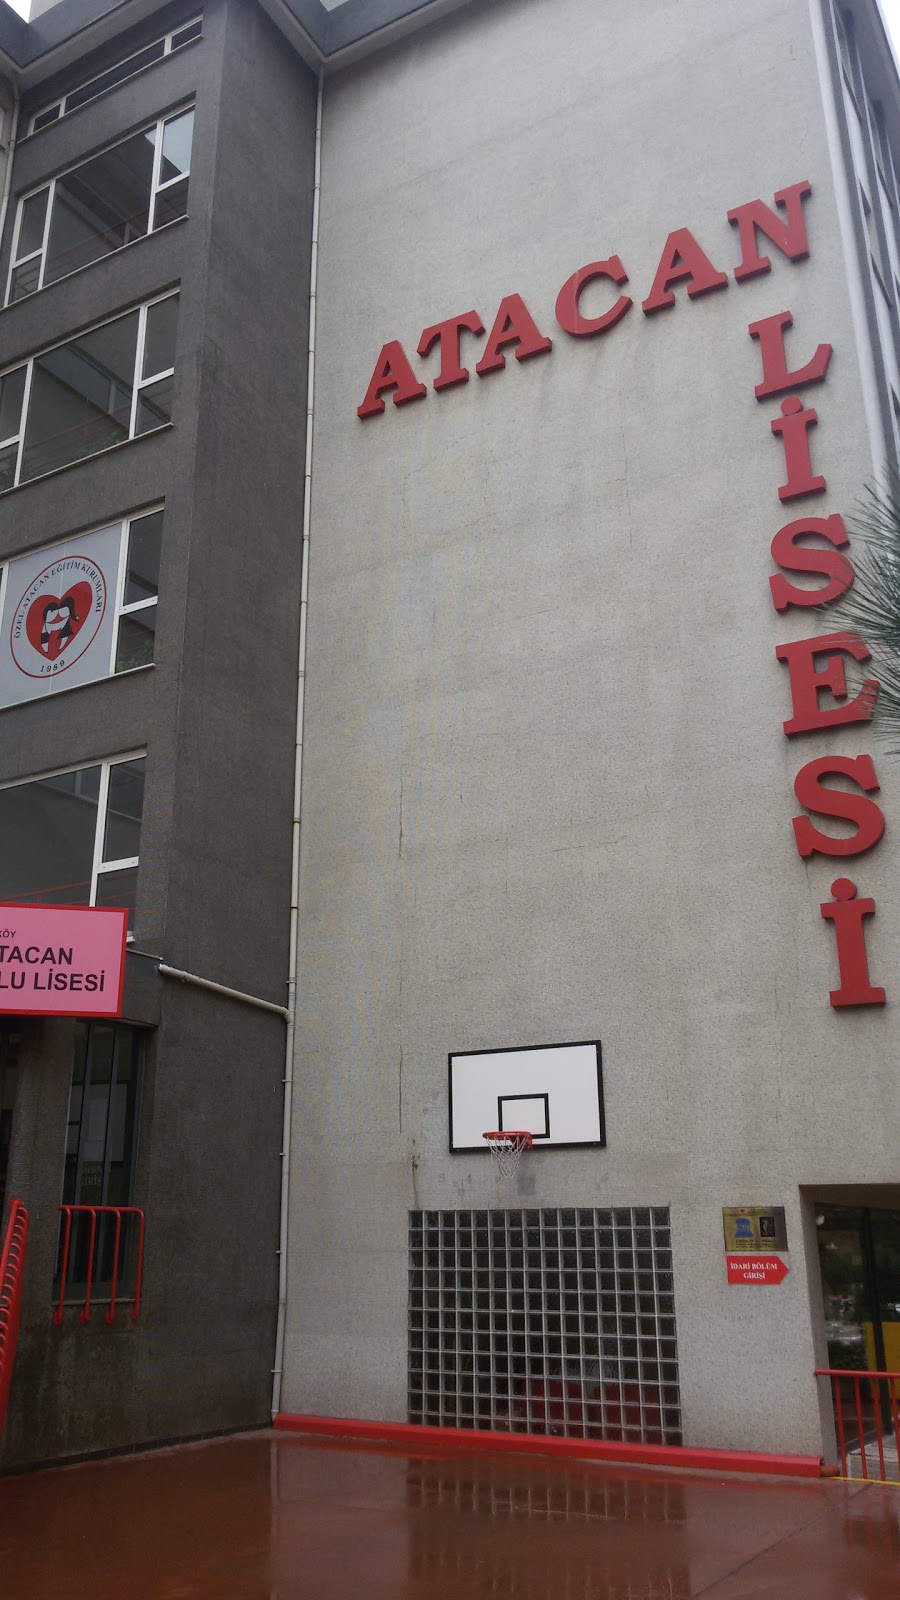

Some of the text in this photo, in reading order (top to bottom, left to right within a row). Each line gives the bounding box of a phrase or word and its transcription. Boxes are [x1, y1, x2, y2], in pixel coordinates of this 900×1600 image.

[357, 180, 813, 420] ATACAN
[14, 611, 25, 639] ÖZEL
[23, 574, 50, 610] ATACAN
[81, 563, 103, 613] KURUMLARI
[40, 659, 65, 673] 1989
[748, 310, 887, 1009] LİSESİ
[0, 945, 73, 965] TACAN
[33, 968, 105, 992] LİSESİ
[730, 1262, 778, 1270] İDARİ BÖLÜM
